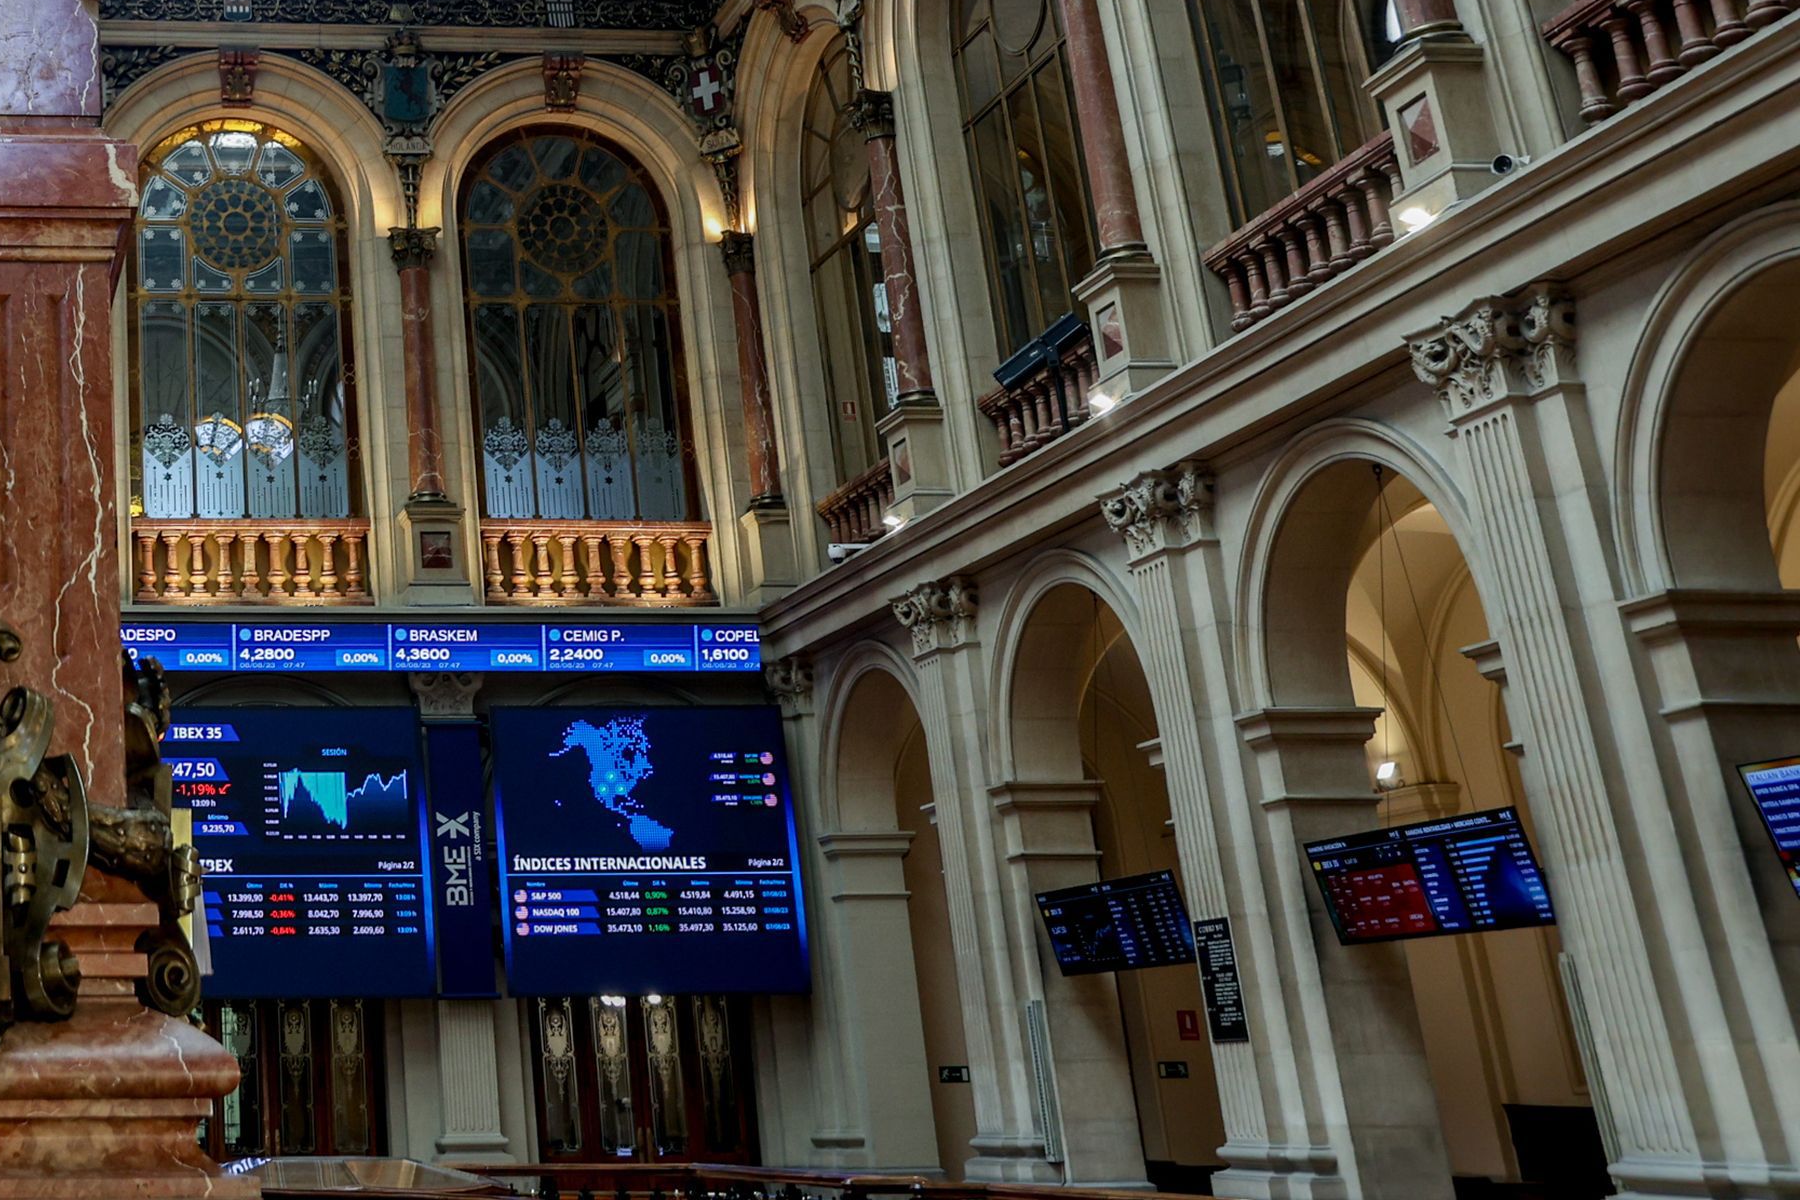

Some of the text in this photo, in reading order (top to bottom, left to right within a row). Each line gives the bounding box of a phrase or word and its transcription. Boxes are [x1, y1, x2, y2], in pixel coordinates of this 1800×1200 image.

[254, 630, 330, 641] BRADESPP
[410, 630, 478, 641] BRASKEM
[563, 630, 625, 641] CEMIG P.
[715, 630, 760, 641] COPEL
[187, 653, 222, 664] 0,00%
[240, 648, 378, 664] 4,2800 0,00%
[396, 648, 533, 664] 4,3600 0,00%
[550, 648, 685, 664] 2,2400 0,00%
[702, 649, 748, 661] 1,6100
[173, 728, 222, 739] IBEX 35
[322, 747, 347, 756] SESIÓN
[176, 784, 215, 796] -1,19%
[202, 825, 234, 834] 9.235,70
[472, 811, 481, 843] company
[378, 861, 401, 870] Página
[402, 861, 414, 869] 2/2
[514, 855, 784, 871] ÍNDICES INTERNACIONALES Página 2/2
[443, 846, 469, 906] BME
[228, 894, 383, 902] 13.399,90 13.443,70 13.397,70
[531, 890, 754, 900] S&P 500 4.518,44 4.519,84 4.491,15
[232, 910, 383, 919] 7.998,50 8.042,70 7.996,90
[533, 909, 564, 918] NASDAQ
[566, 908, 579, 916] 100
[606, 908, 641, 916] 15.407,80
[678, 907, 712, 916] 15.410,80
[233, 927, 384, 935] 2.611,70 2.635,30 2.609,60
[534, 923, 758, 934] DOW JONES 35.473,10 35.497,30 35.125,60
